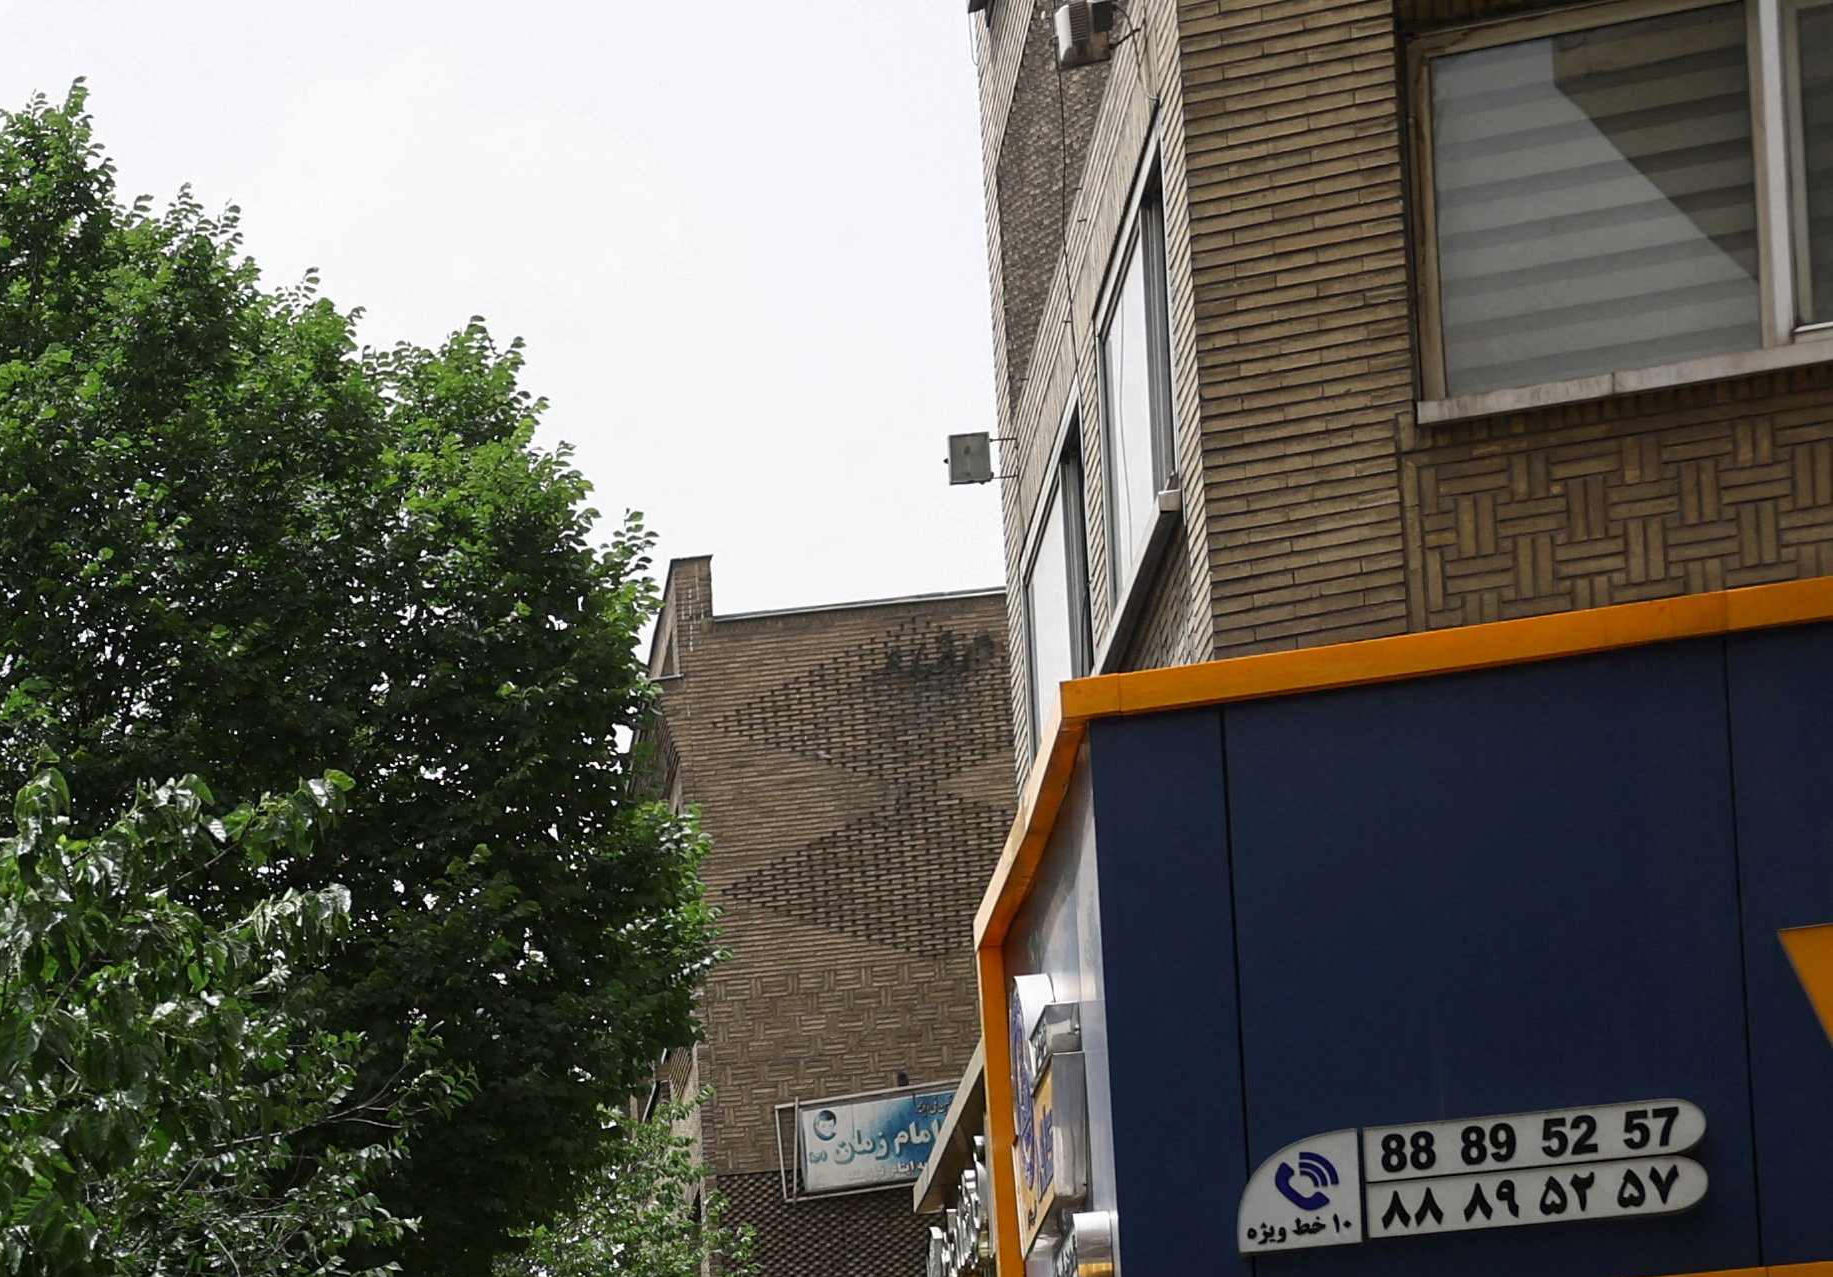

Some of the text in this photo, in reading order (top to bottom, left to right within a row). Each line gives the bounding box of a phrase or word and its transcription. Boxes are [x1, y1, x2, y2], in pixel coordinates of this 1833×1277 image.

[834, 1130, 888, 1164] زمان
[1381, 1107, 1679, 1173] 88 89 52 57
[1382, 1165, 1679, 1229] ۸۸ ۸۹ ۵۲ ۵۷
[1247, 1213, 1352, 1245] ۱۰ خط ویژه
